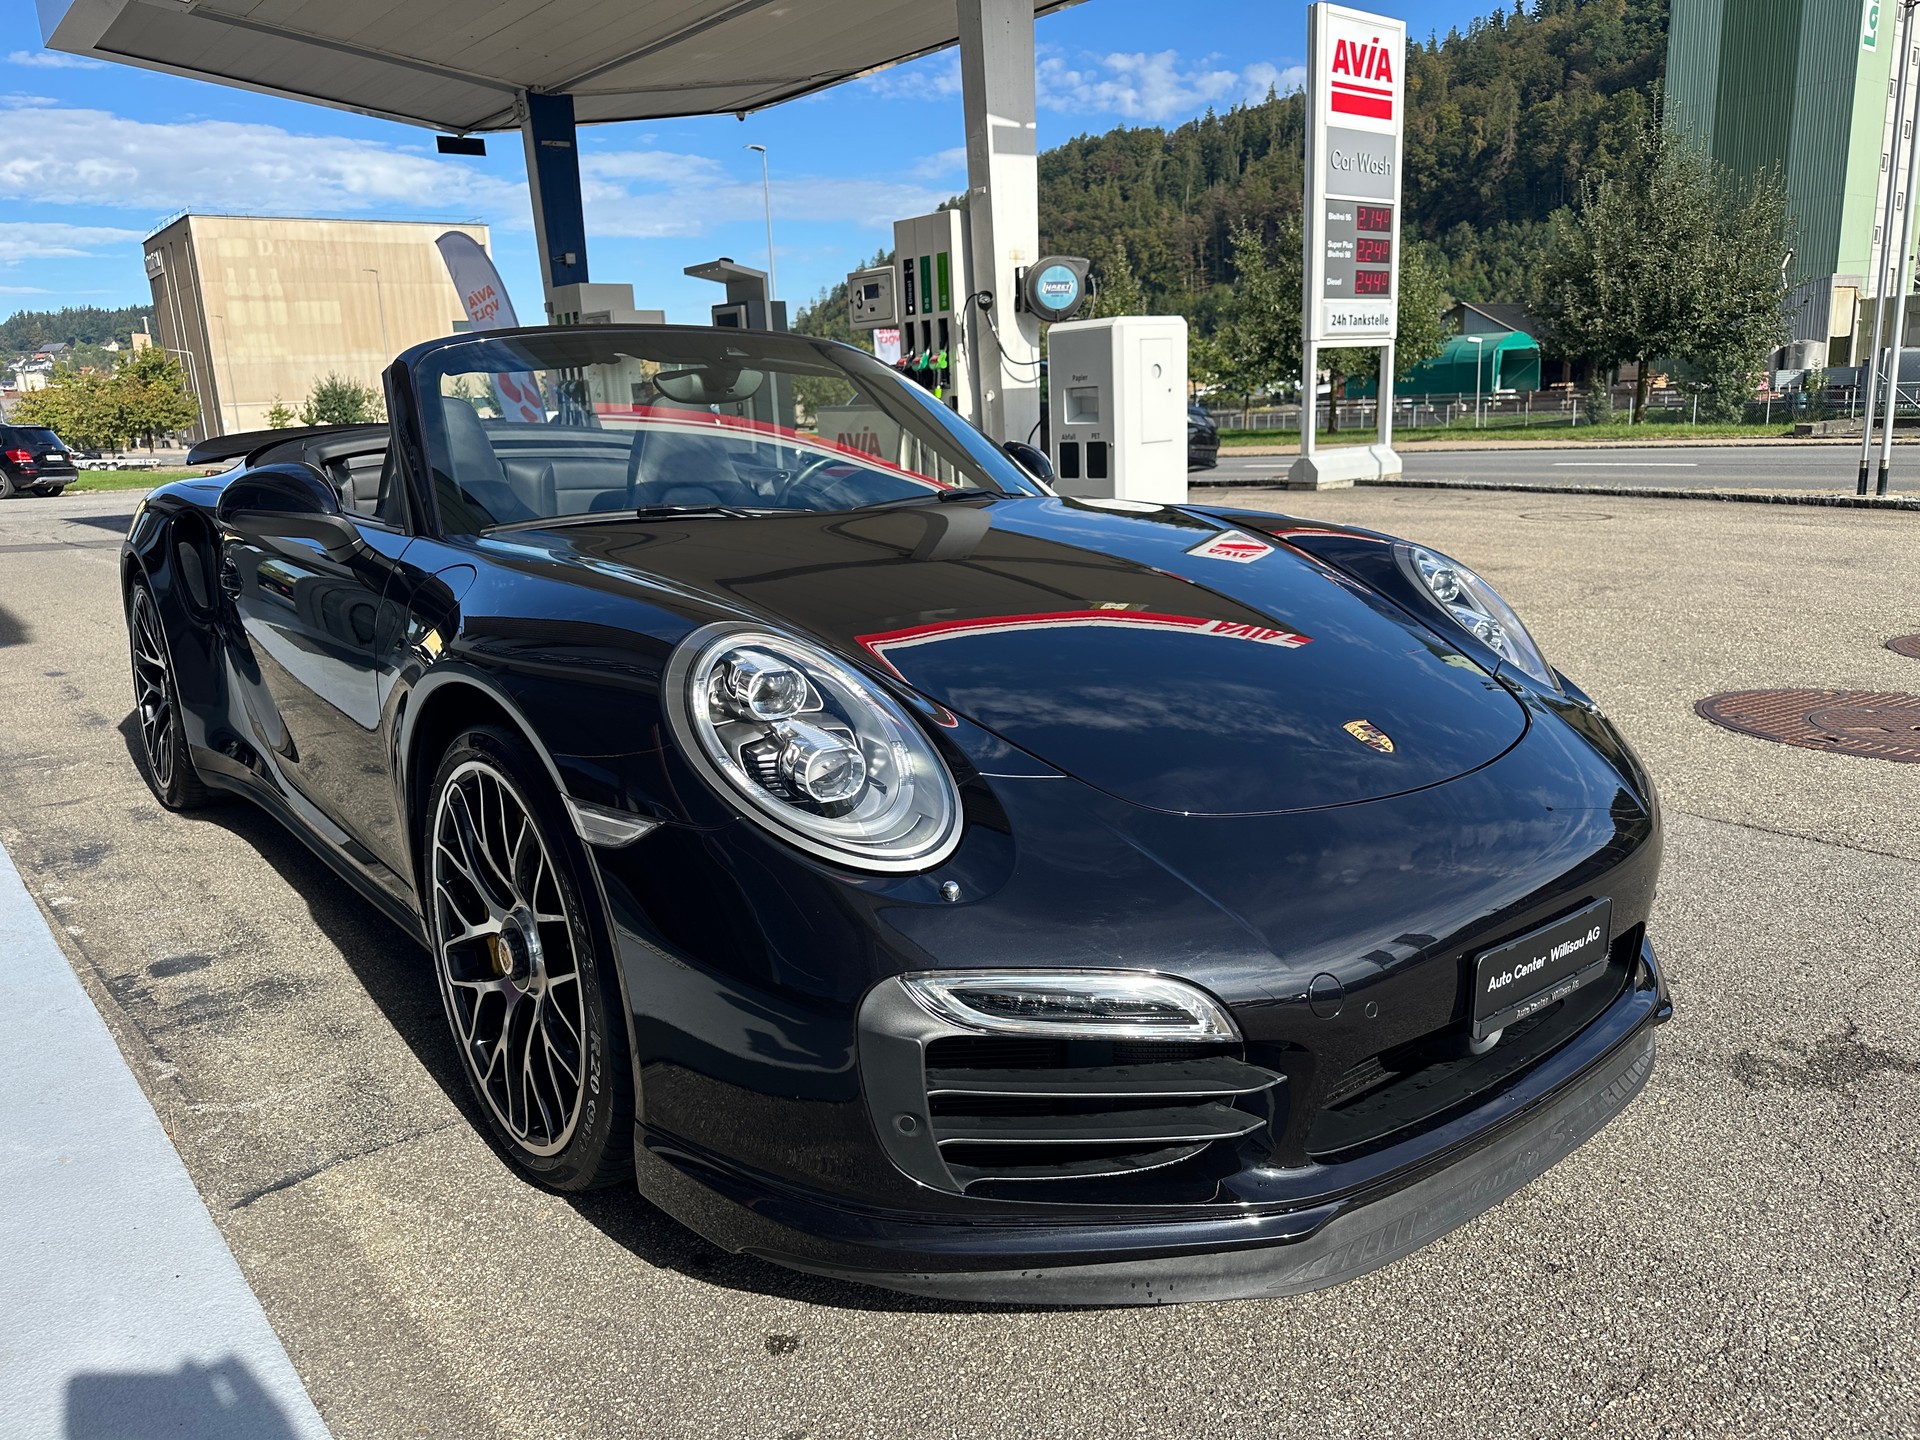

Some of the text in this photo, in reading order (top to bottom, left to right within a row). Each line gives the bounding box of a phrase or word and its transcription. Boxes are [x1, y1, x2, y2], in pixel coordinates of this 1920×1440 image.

[1332, 37, 1393, 83] AVIA
[1331, 149, 1391, 176] Car Wash
[1327, 240, 1342, 249] Super
[1327, 278, 1342, 286] Diesel
[856, 289, 863, 310] 3
[1331, 314, 1389, 326] 24h Tankstelle
[1072, 373, 1088, 384] Papier
[836, 426, 882, 458] AVIA
[1061, 433, 1077, 441] Abfall
[1091, 432, 1100, 440] PET
[1487, 926, 1600, 993] Auto Center Willisau AG
